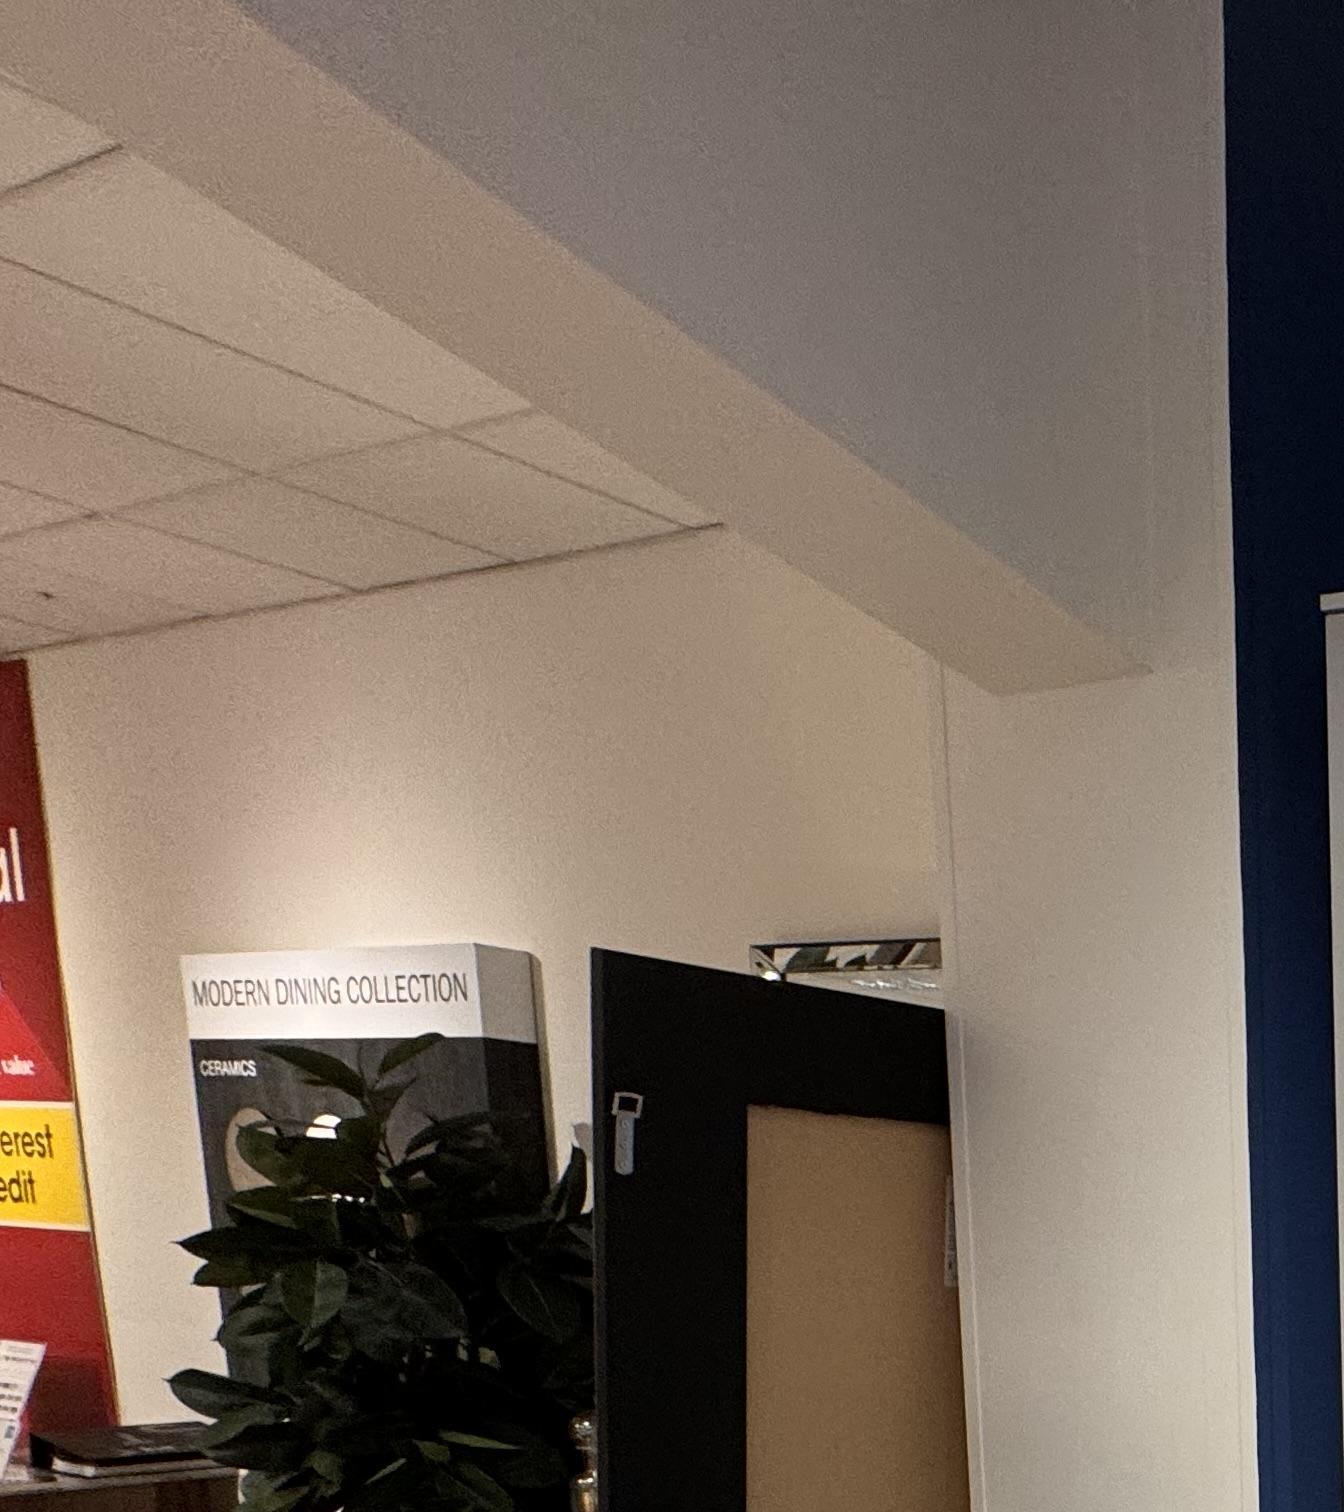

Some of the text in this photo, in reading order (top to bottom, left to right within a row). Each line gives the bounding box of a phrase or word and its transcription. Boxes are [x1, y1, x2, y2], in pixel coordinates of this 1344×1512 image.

[191, 973, 468, 1007] MODERN DINING COLLECTION
[199, 1059, 258, 1078] CERAMICS
